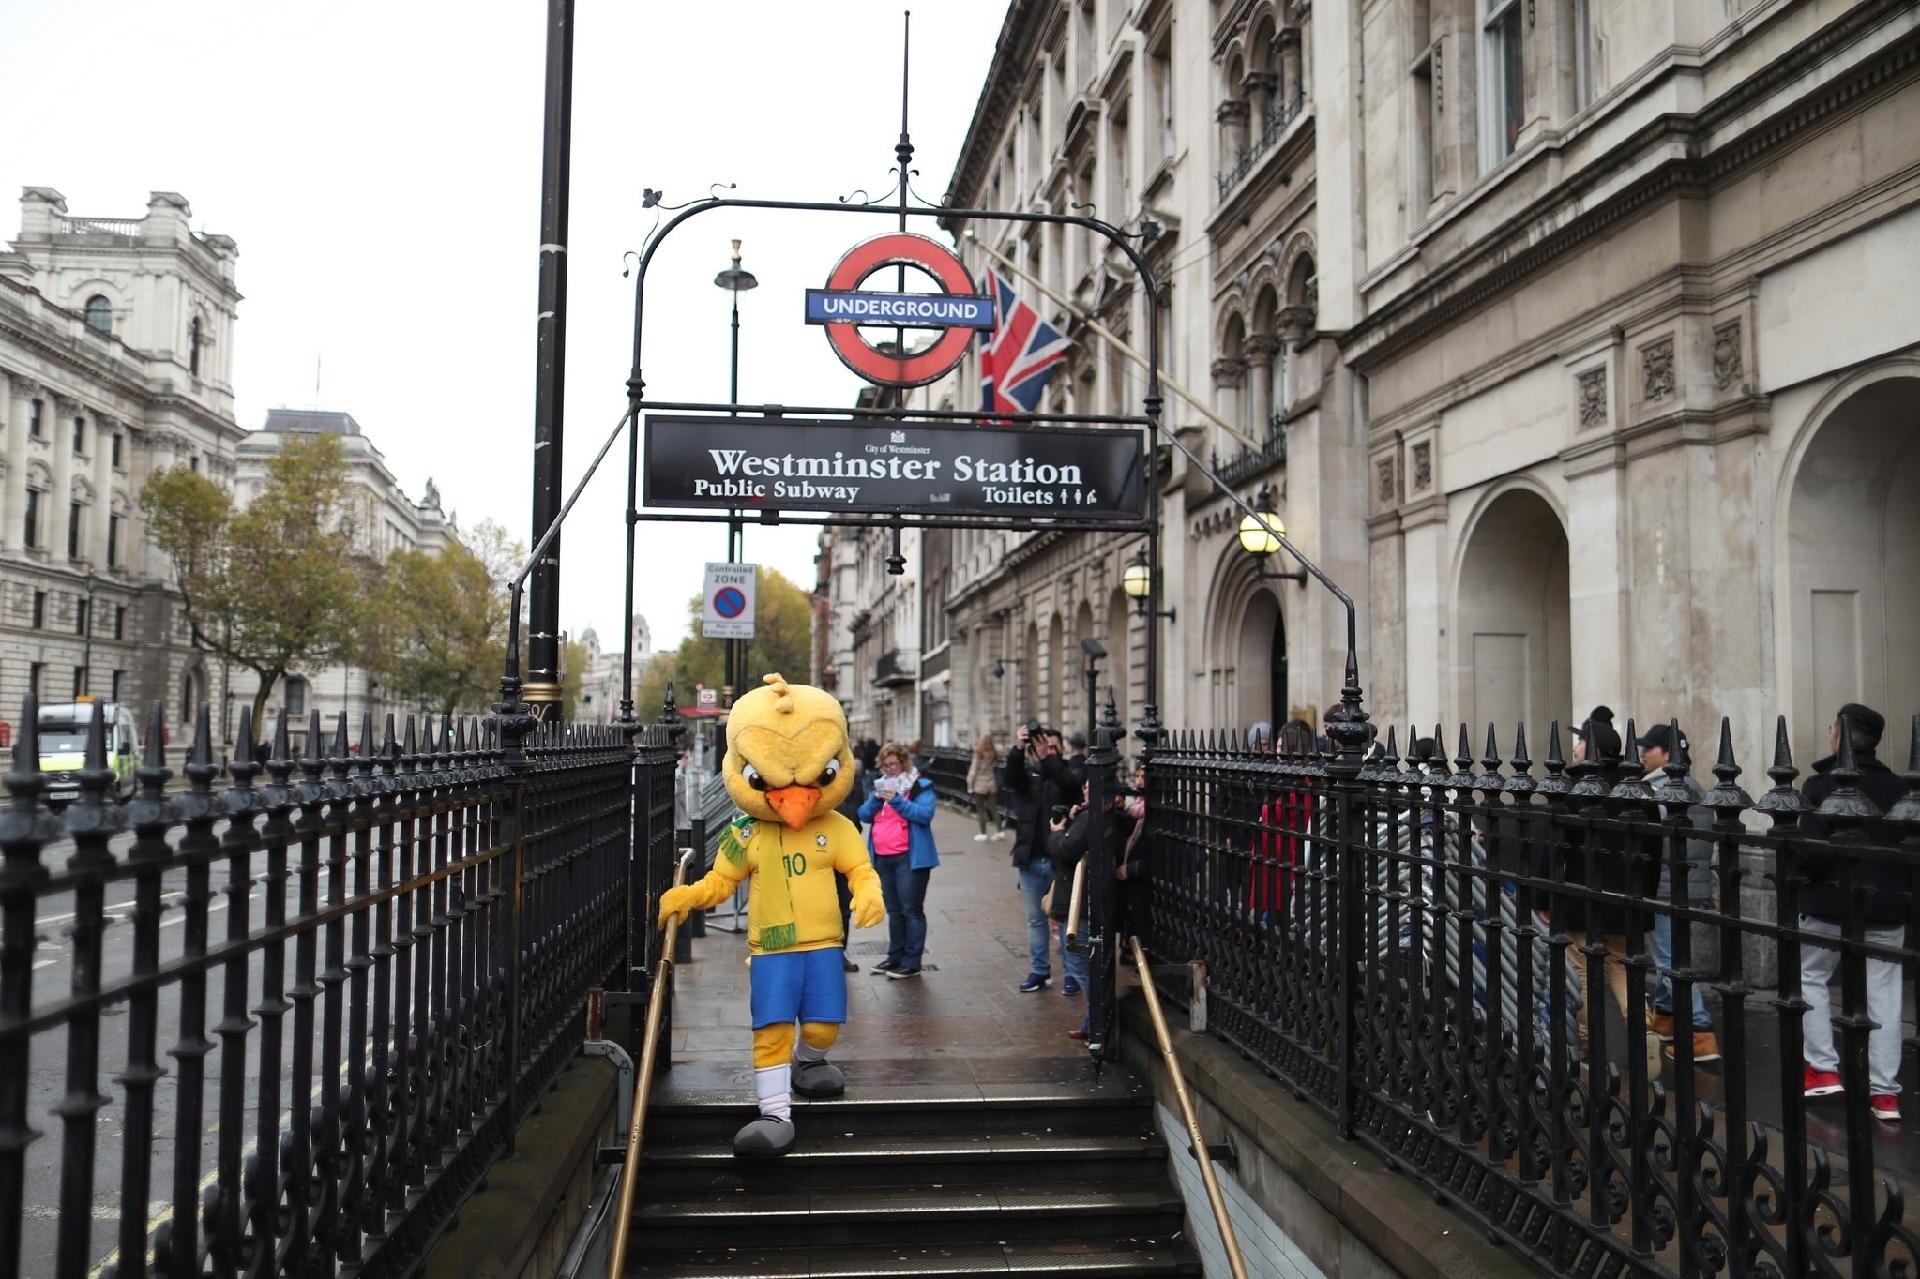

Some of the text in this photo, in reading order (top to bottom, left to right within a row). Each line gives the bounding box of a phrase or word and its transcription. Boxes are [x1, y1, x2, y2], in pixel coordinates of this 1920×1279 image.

[823, 298, 978, 319] UNDERGROUND
[865, 444, 930, 455] City of Westminster
[708, 449, 1082, 485] Westminster Station
[694, 479, 861, 503] Public Subway
[982, 486, 1054, 505] Toilets
[708, 564, 753, 574] Controlled
[714, 575, 746, 584] ZONE
[782, 852, 806, 878] 10
